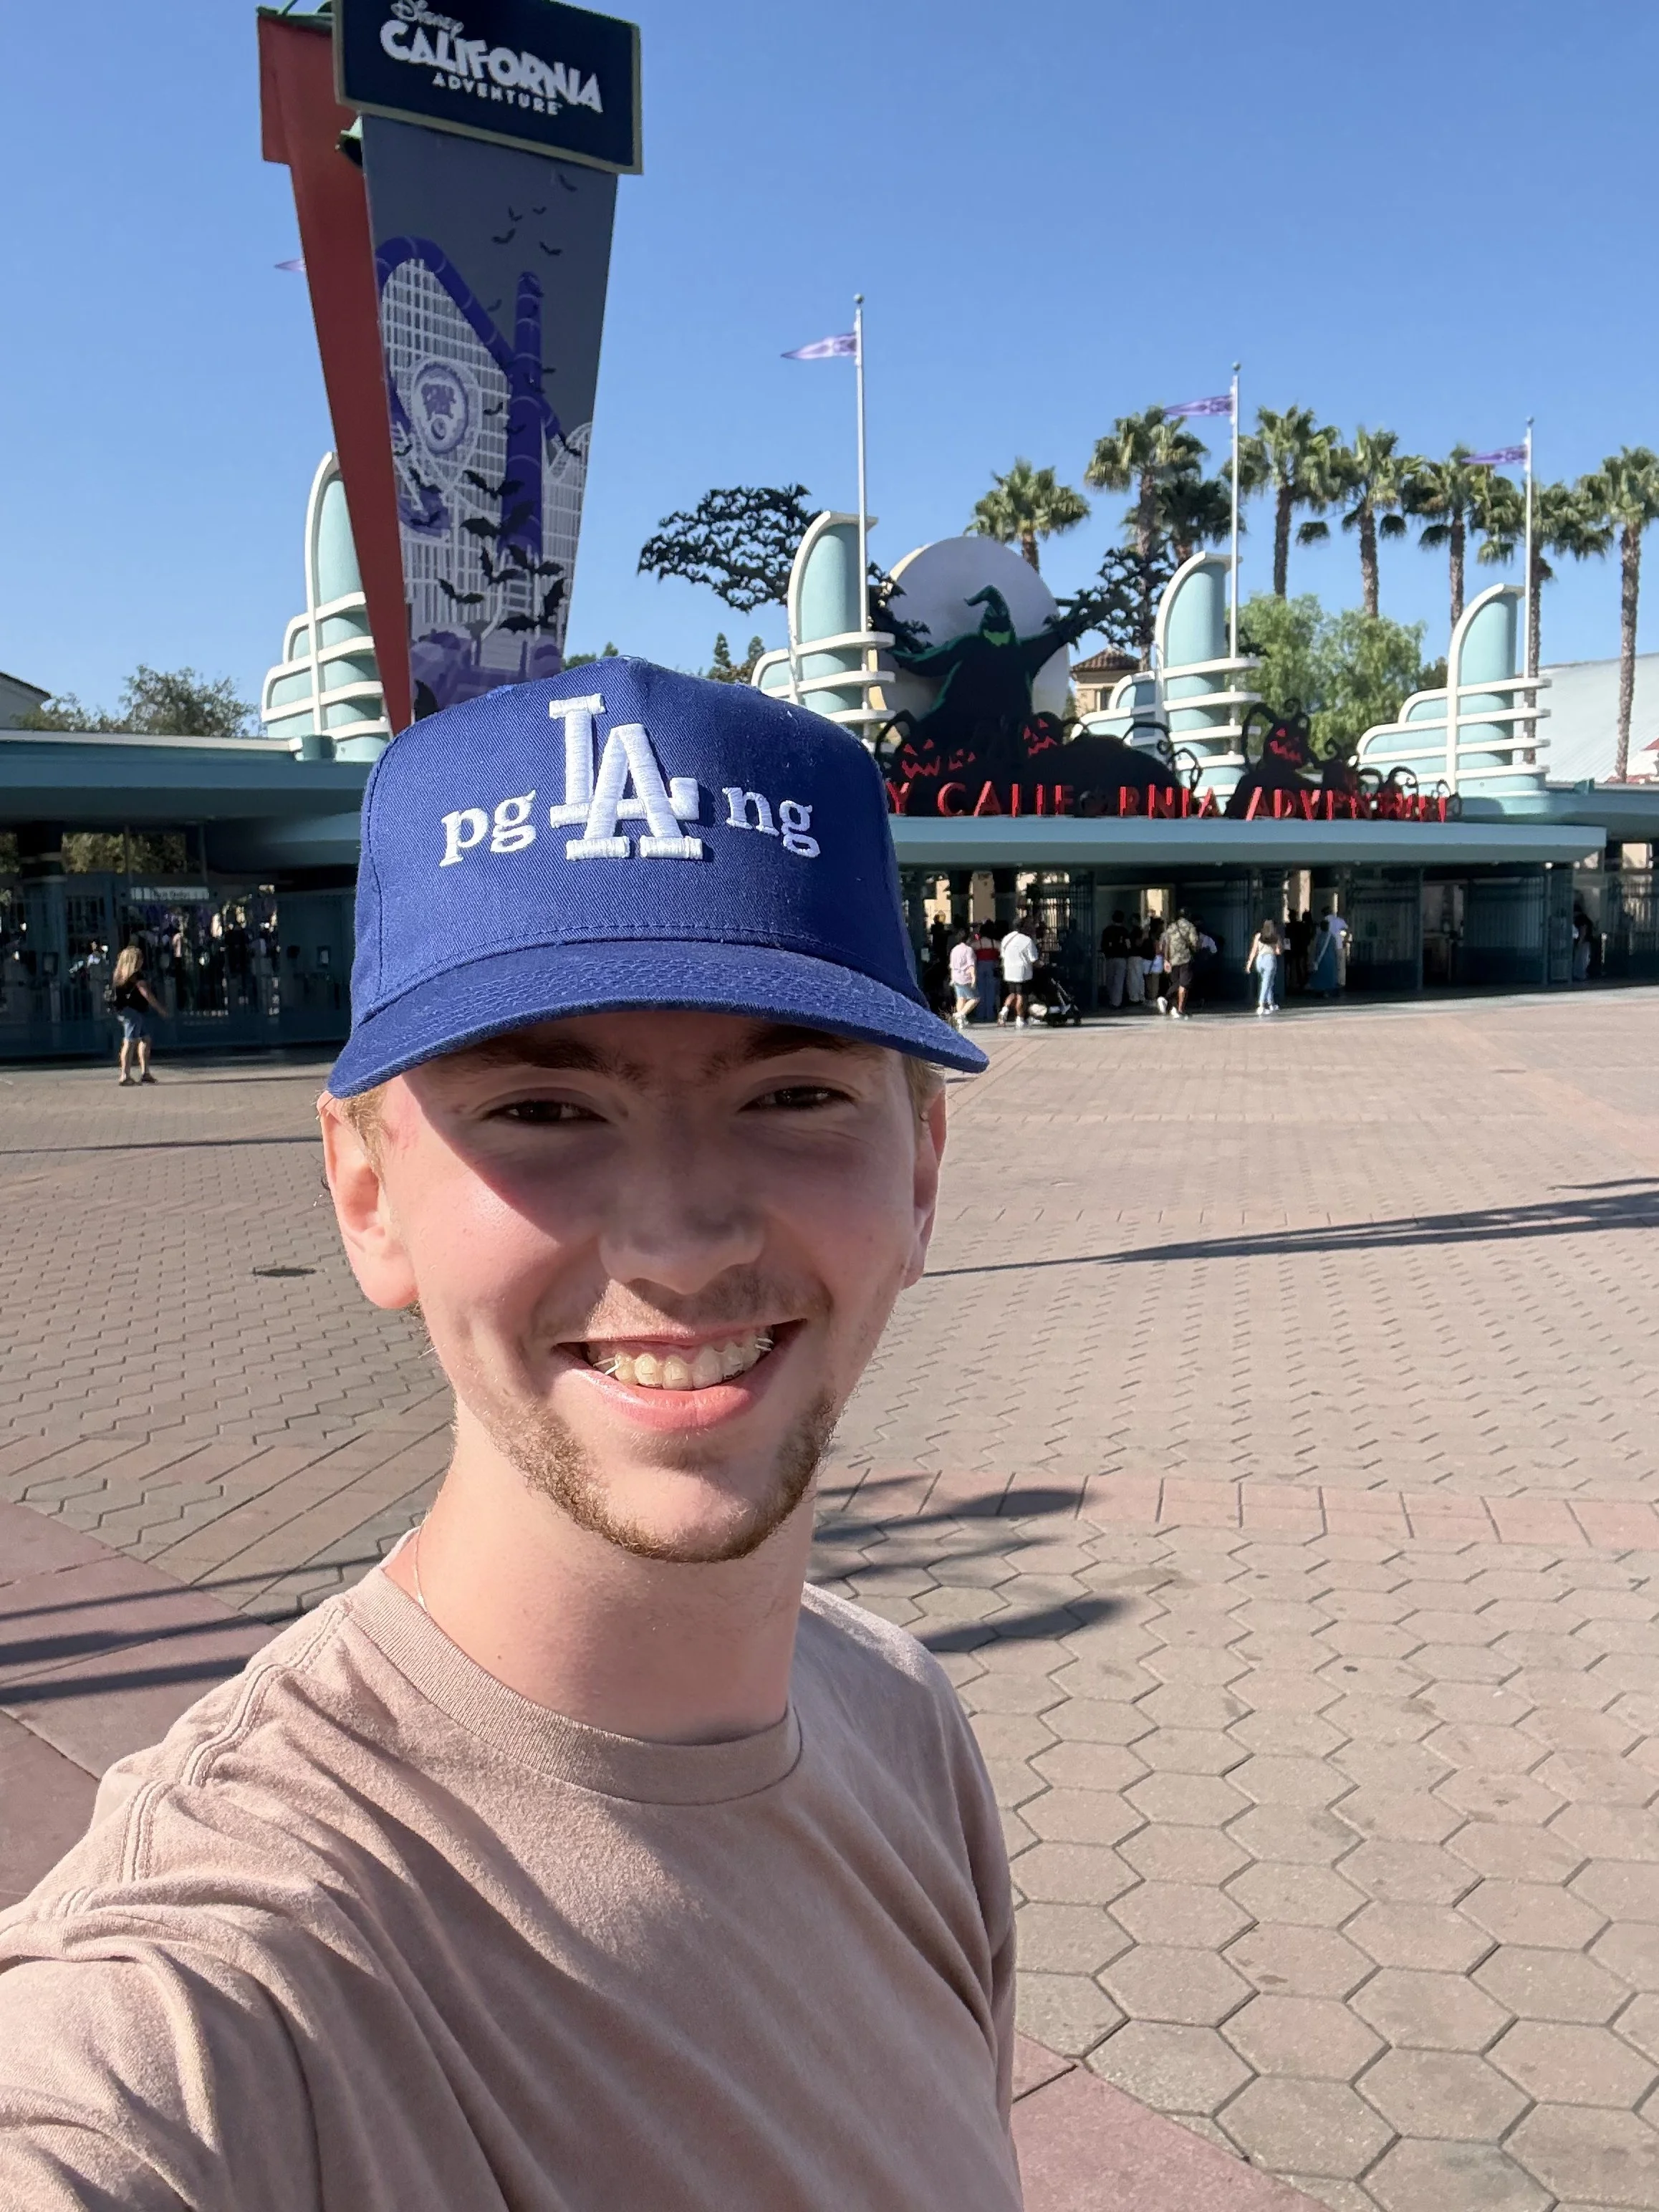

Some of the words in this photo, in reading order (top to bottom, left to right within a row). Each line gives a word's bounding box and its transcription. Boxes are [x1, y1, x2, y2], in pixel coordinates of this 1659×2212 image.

[380, 19, 603, 113] CALIFORNIA
[432, 72, 559, 115] ADVENTURE
[938, 781, 1223, 819] CALIFRNIA
